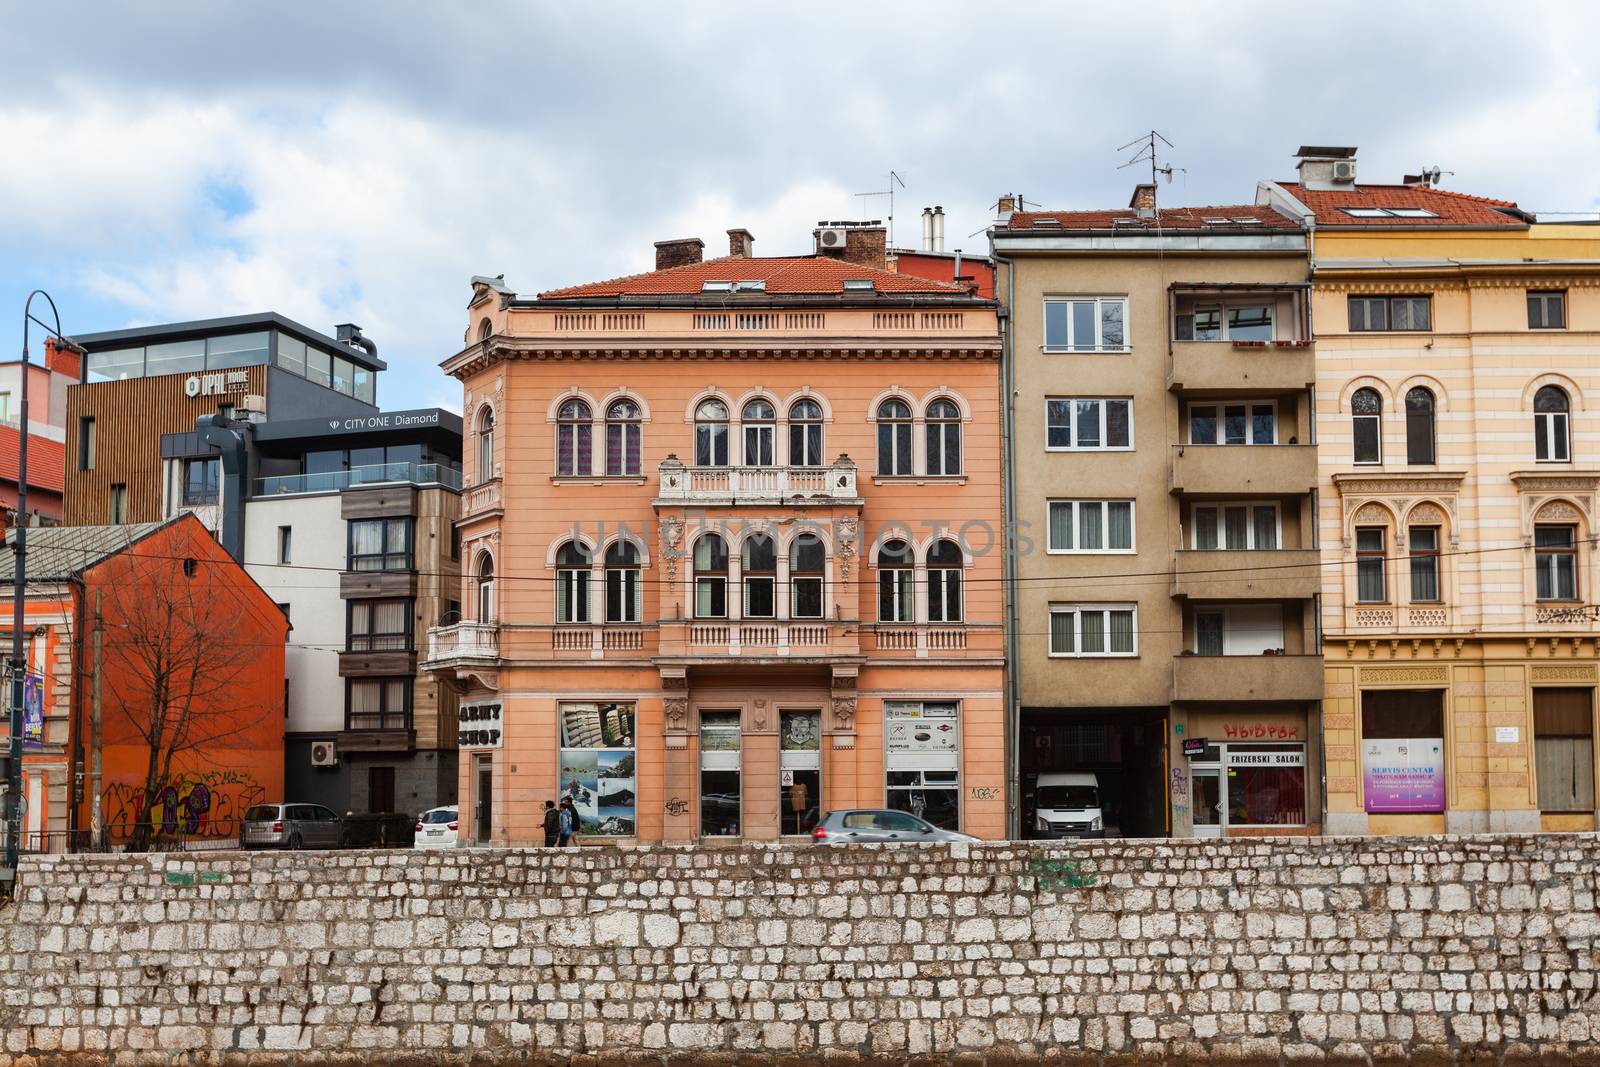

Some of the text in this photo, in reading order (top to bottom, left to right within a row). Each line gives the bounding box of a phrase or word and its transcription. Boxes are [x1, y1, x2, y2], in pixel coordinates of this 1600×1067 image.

[202, 374, 228, 395] OPAL
[345, 411, 439, 430] CITY ONE Diamond
[459, 704, 501, 722] ARMY
[459, 729, 501, 746] SHOP
[1231, 755, 1300, 763] FRIZERSKI SALON
